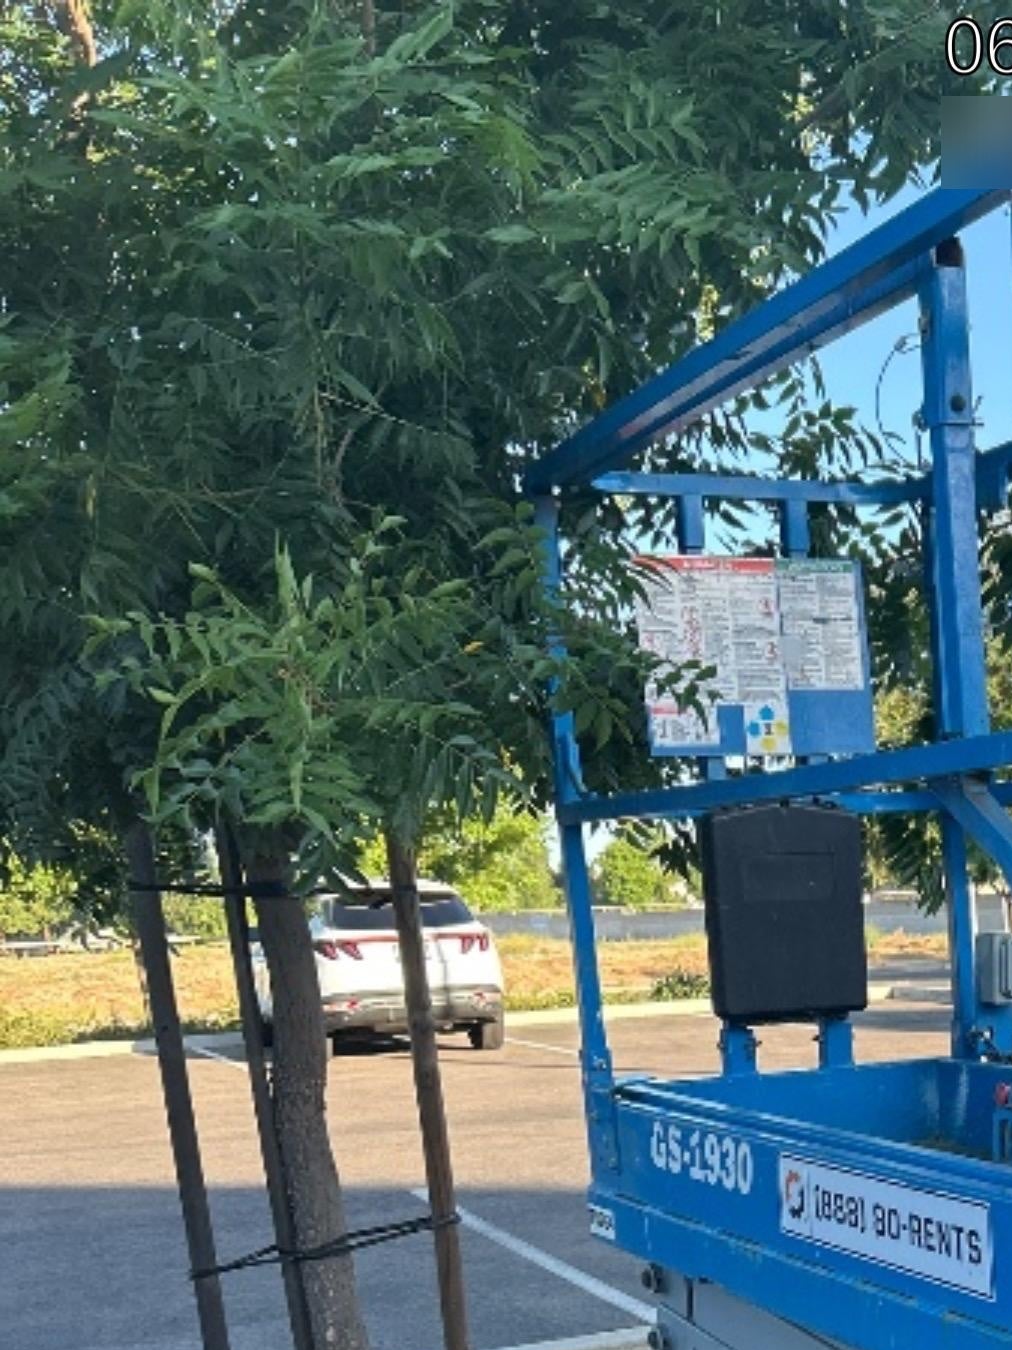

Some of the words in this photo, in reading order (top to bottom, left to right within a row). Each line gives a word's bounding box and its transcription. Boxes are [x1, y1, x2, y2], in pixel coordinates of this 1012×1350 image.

[650, 1121, 753, 1195] GS-1930
[815, 1184, 865, 1234] (888)
[872, 1202, 982, 1265] 90-RENTS
